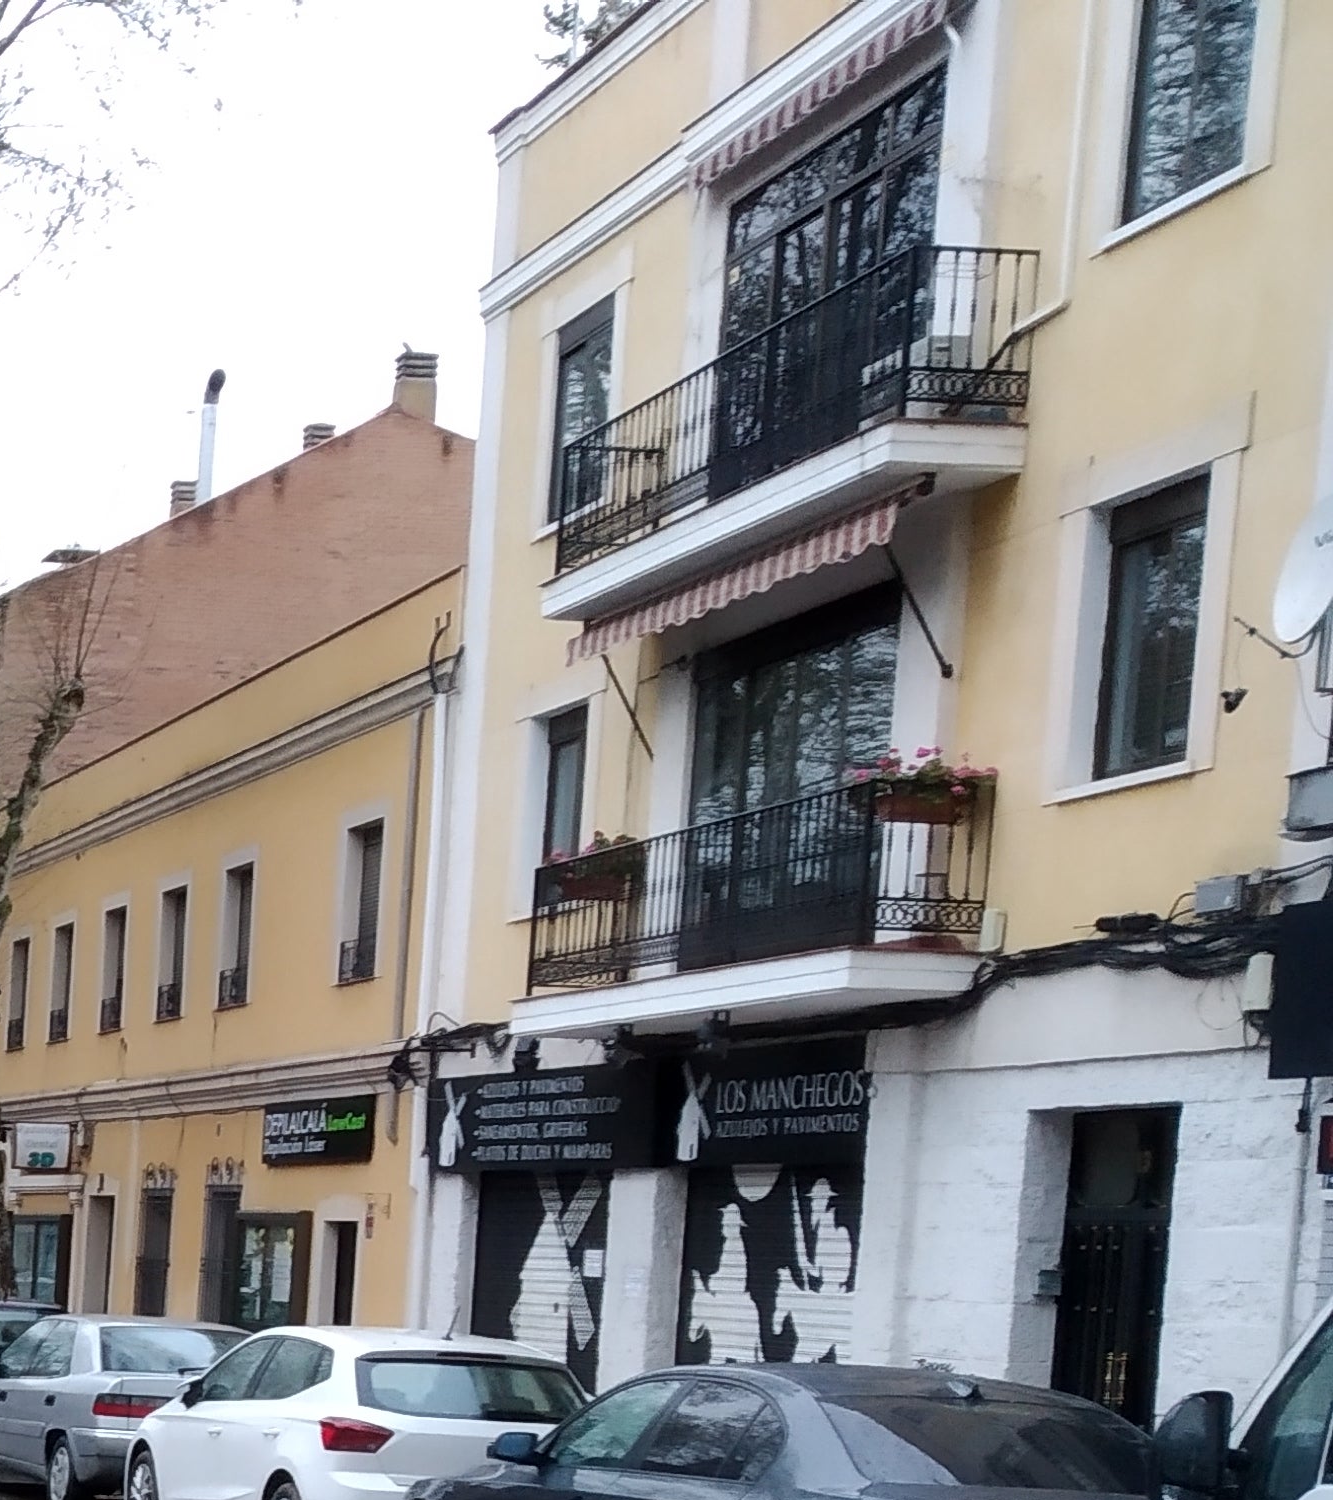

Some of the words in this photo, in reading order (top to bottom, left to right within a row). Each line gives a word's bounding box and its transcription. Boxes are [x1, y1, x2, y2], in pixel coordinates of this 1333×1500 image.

[715, 1079, 747, 1114] LOS
[749, 1069, 865, 1112] MANCHEGOS
[716, 1118, 769, 1138] AZULEJOS
[772, 1117, 779, 1134] Y
[783, 1112, 861, 1134] PAVIMENTOS
[27, 1151, 56, 1167] 3D
